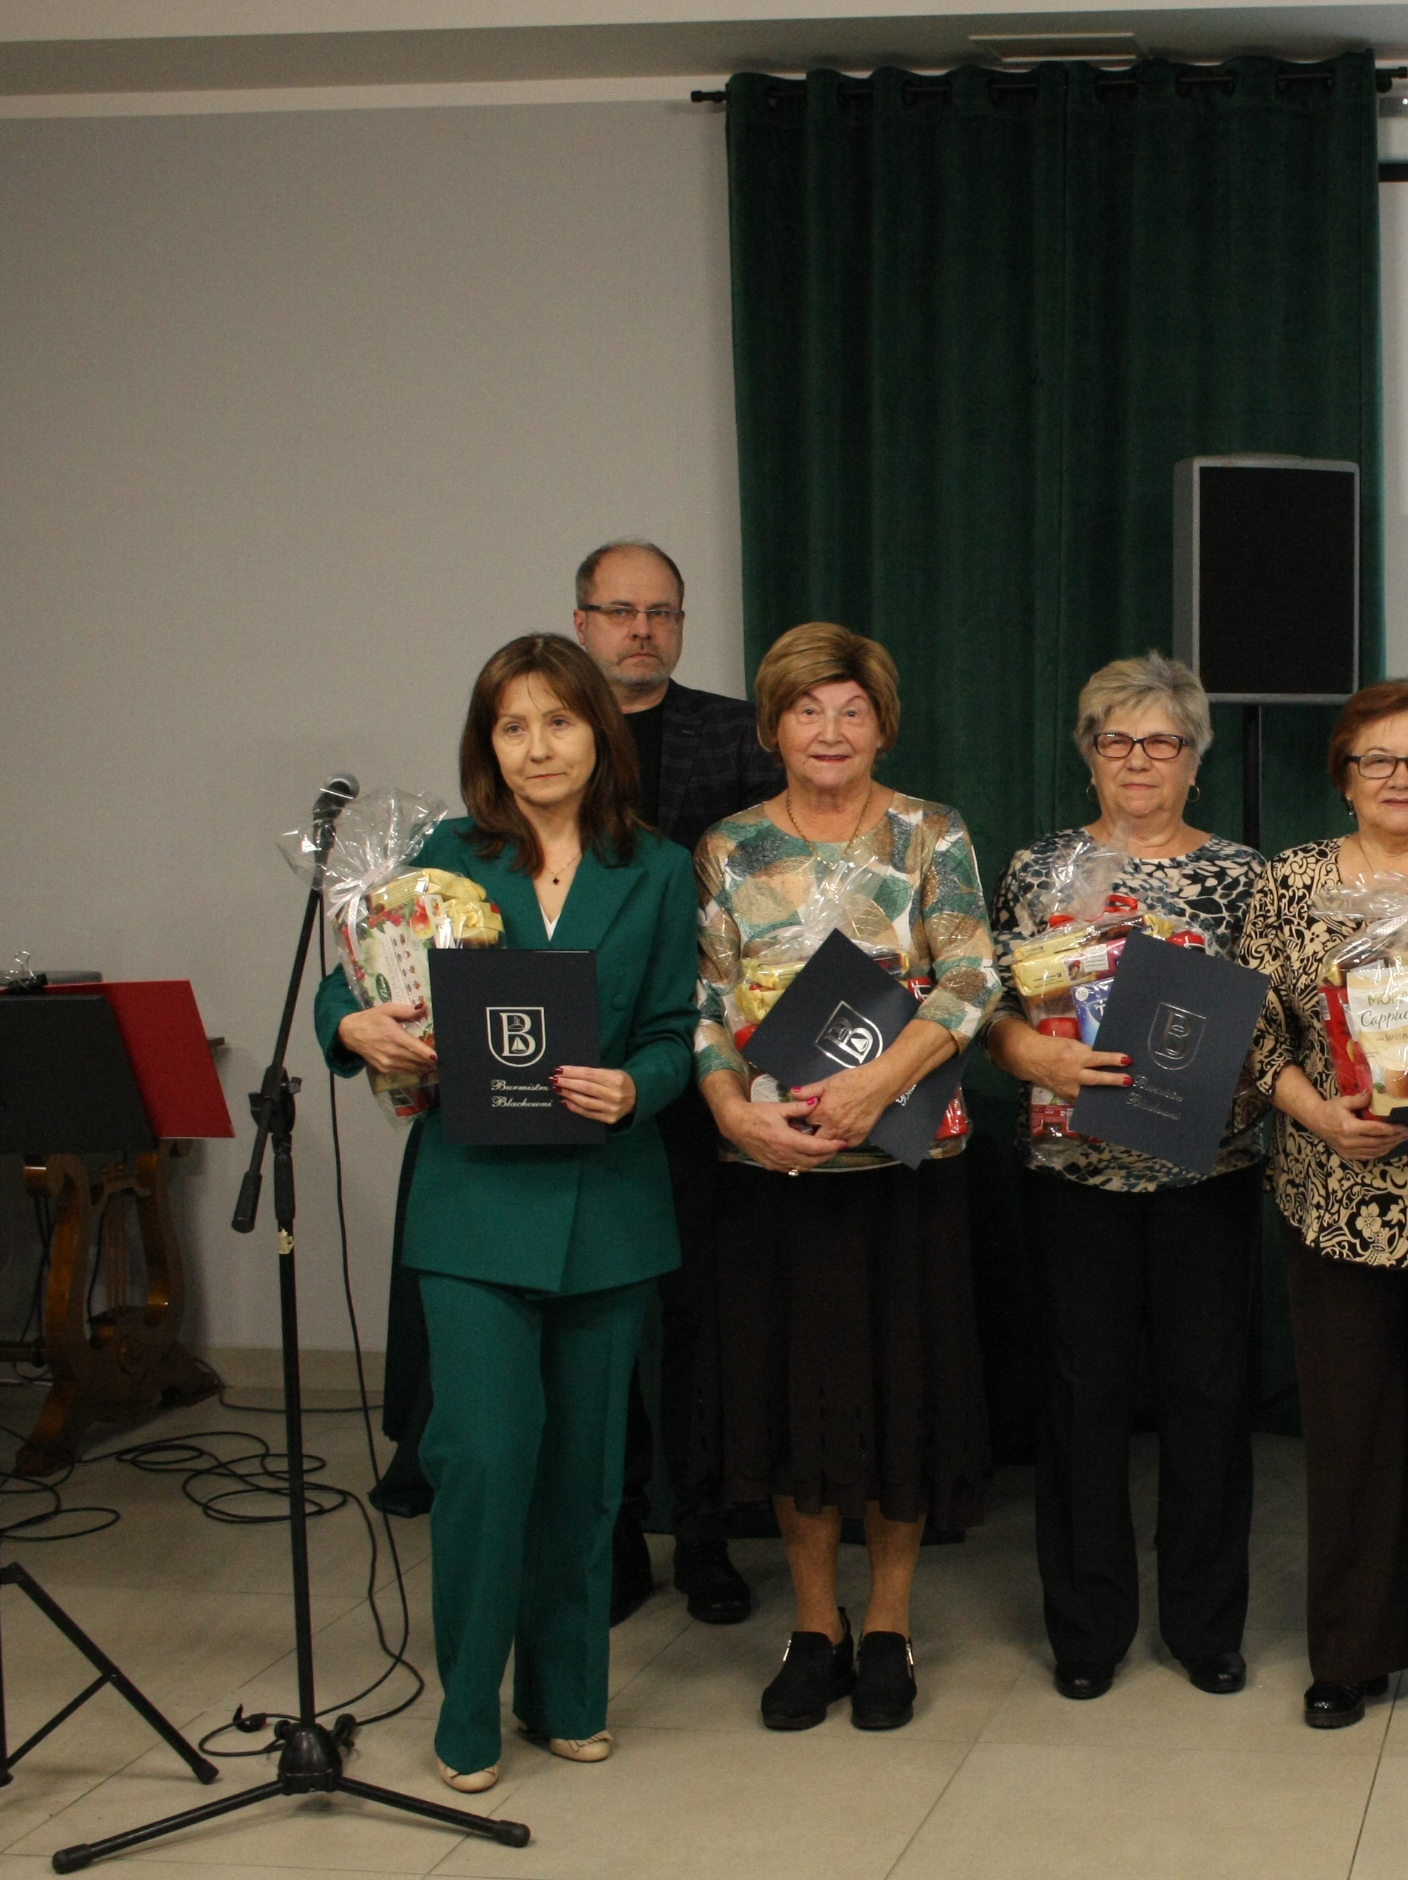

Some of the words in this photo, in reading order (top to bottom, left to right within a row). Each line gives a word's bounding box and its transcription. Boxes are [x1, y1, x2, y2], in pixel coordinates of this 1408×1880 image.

[499, 1012, 536, 1057] B
[490, 1079, 550, 1092] Burmistrz
[491, 1095, 553, 1108] Blachowni
